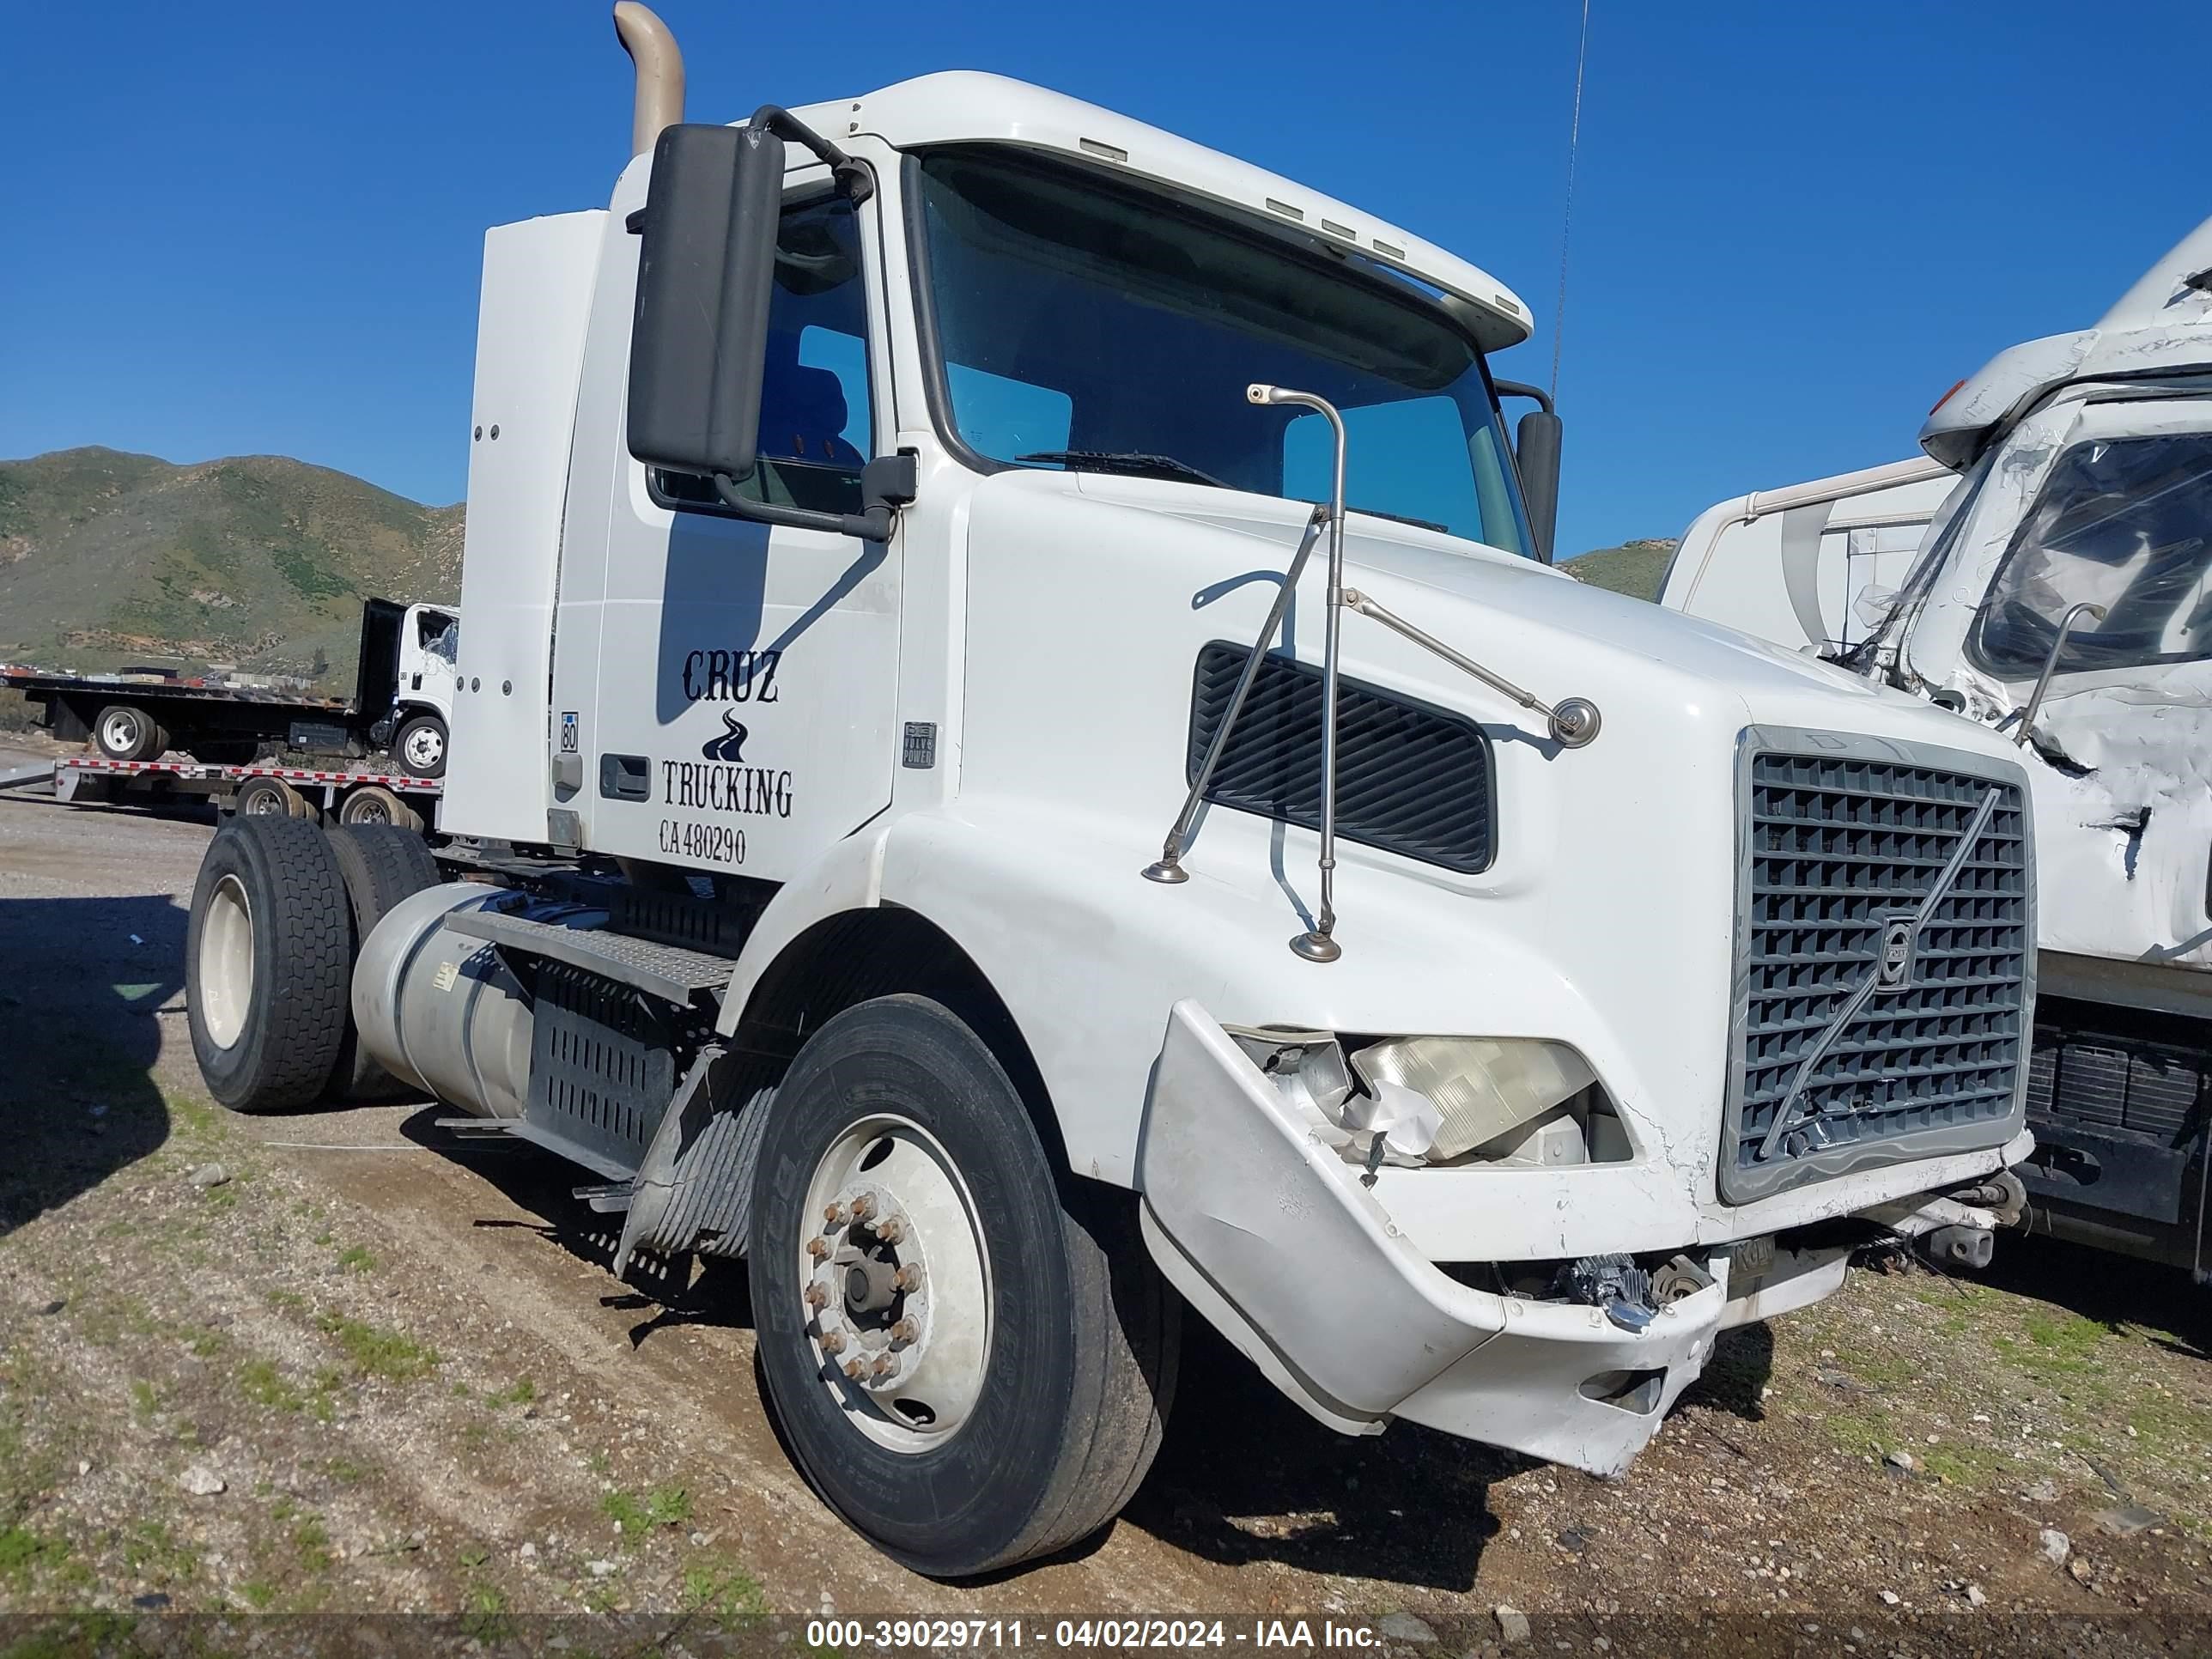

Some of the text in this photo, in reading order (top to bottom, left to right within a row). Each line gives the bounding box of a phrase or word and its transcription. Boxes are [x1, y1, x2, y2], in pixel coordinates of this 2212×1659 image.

[683, 649, 783, 702] CRUZ
[562, 723, 576, 749] 80
[904, 750, 932, 763] POWER
[662, 760, 793, 818] TRUCKING
